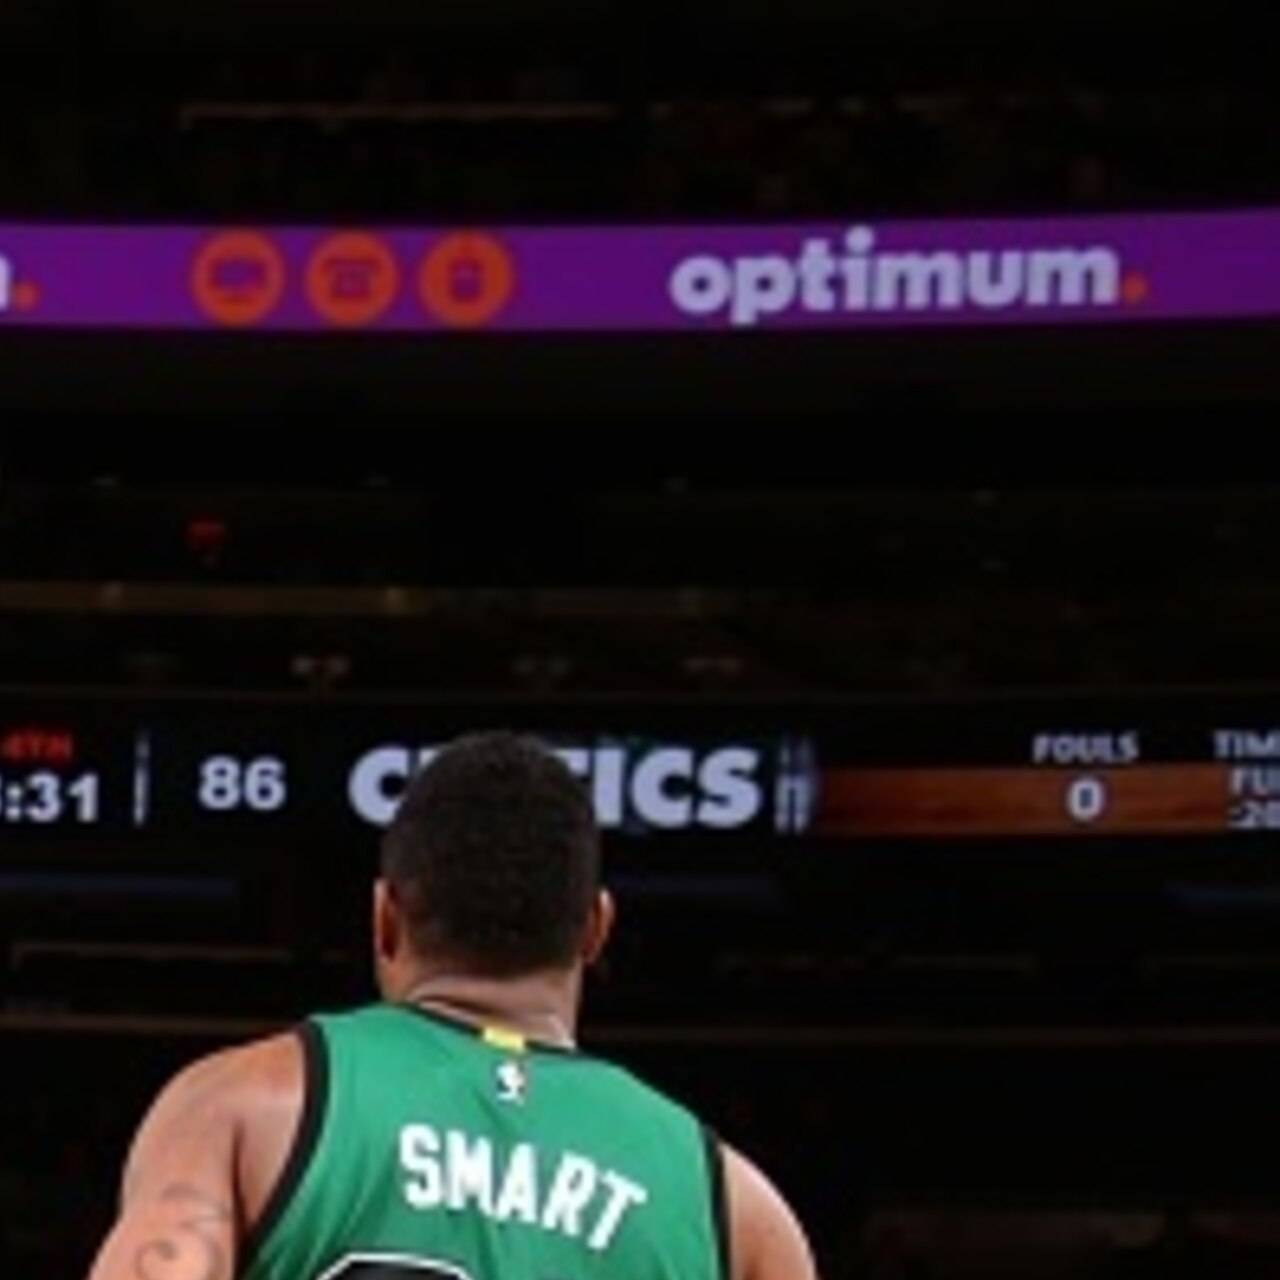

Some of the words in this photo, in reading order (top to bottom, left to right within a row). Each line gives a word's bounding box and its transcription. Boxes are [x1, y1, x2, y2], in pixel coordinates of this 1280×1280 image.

[0, 731, 73, 761] 4TH
[1033, 731, 1138, 763] FOULS
[199, 755, 286, 810] 86
[348, 746, 762, 829] CICS
[1067, 778, 1105, 822] 0
[398, 1123, 647, 1252] SMART
